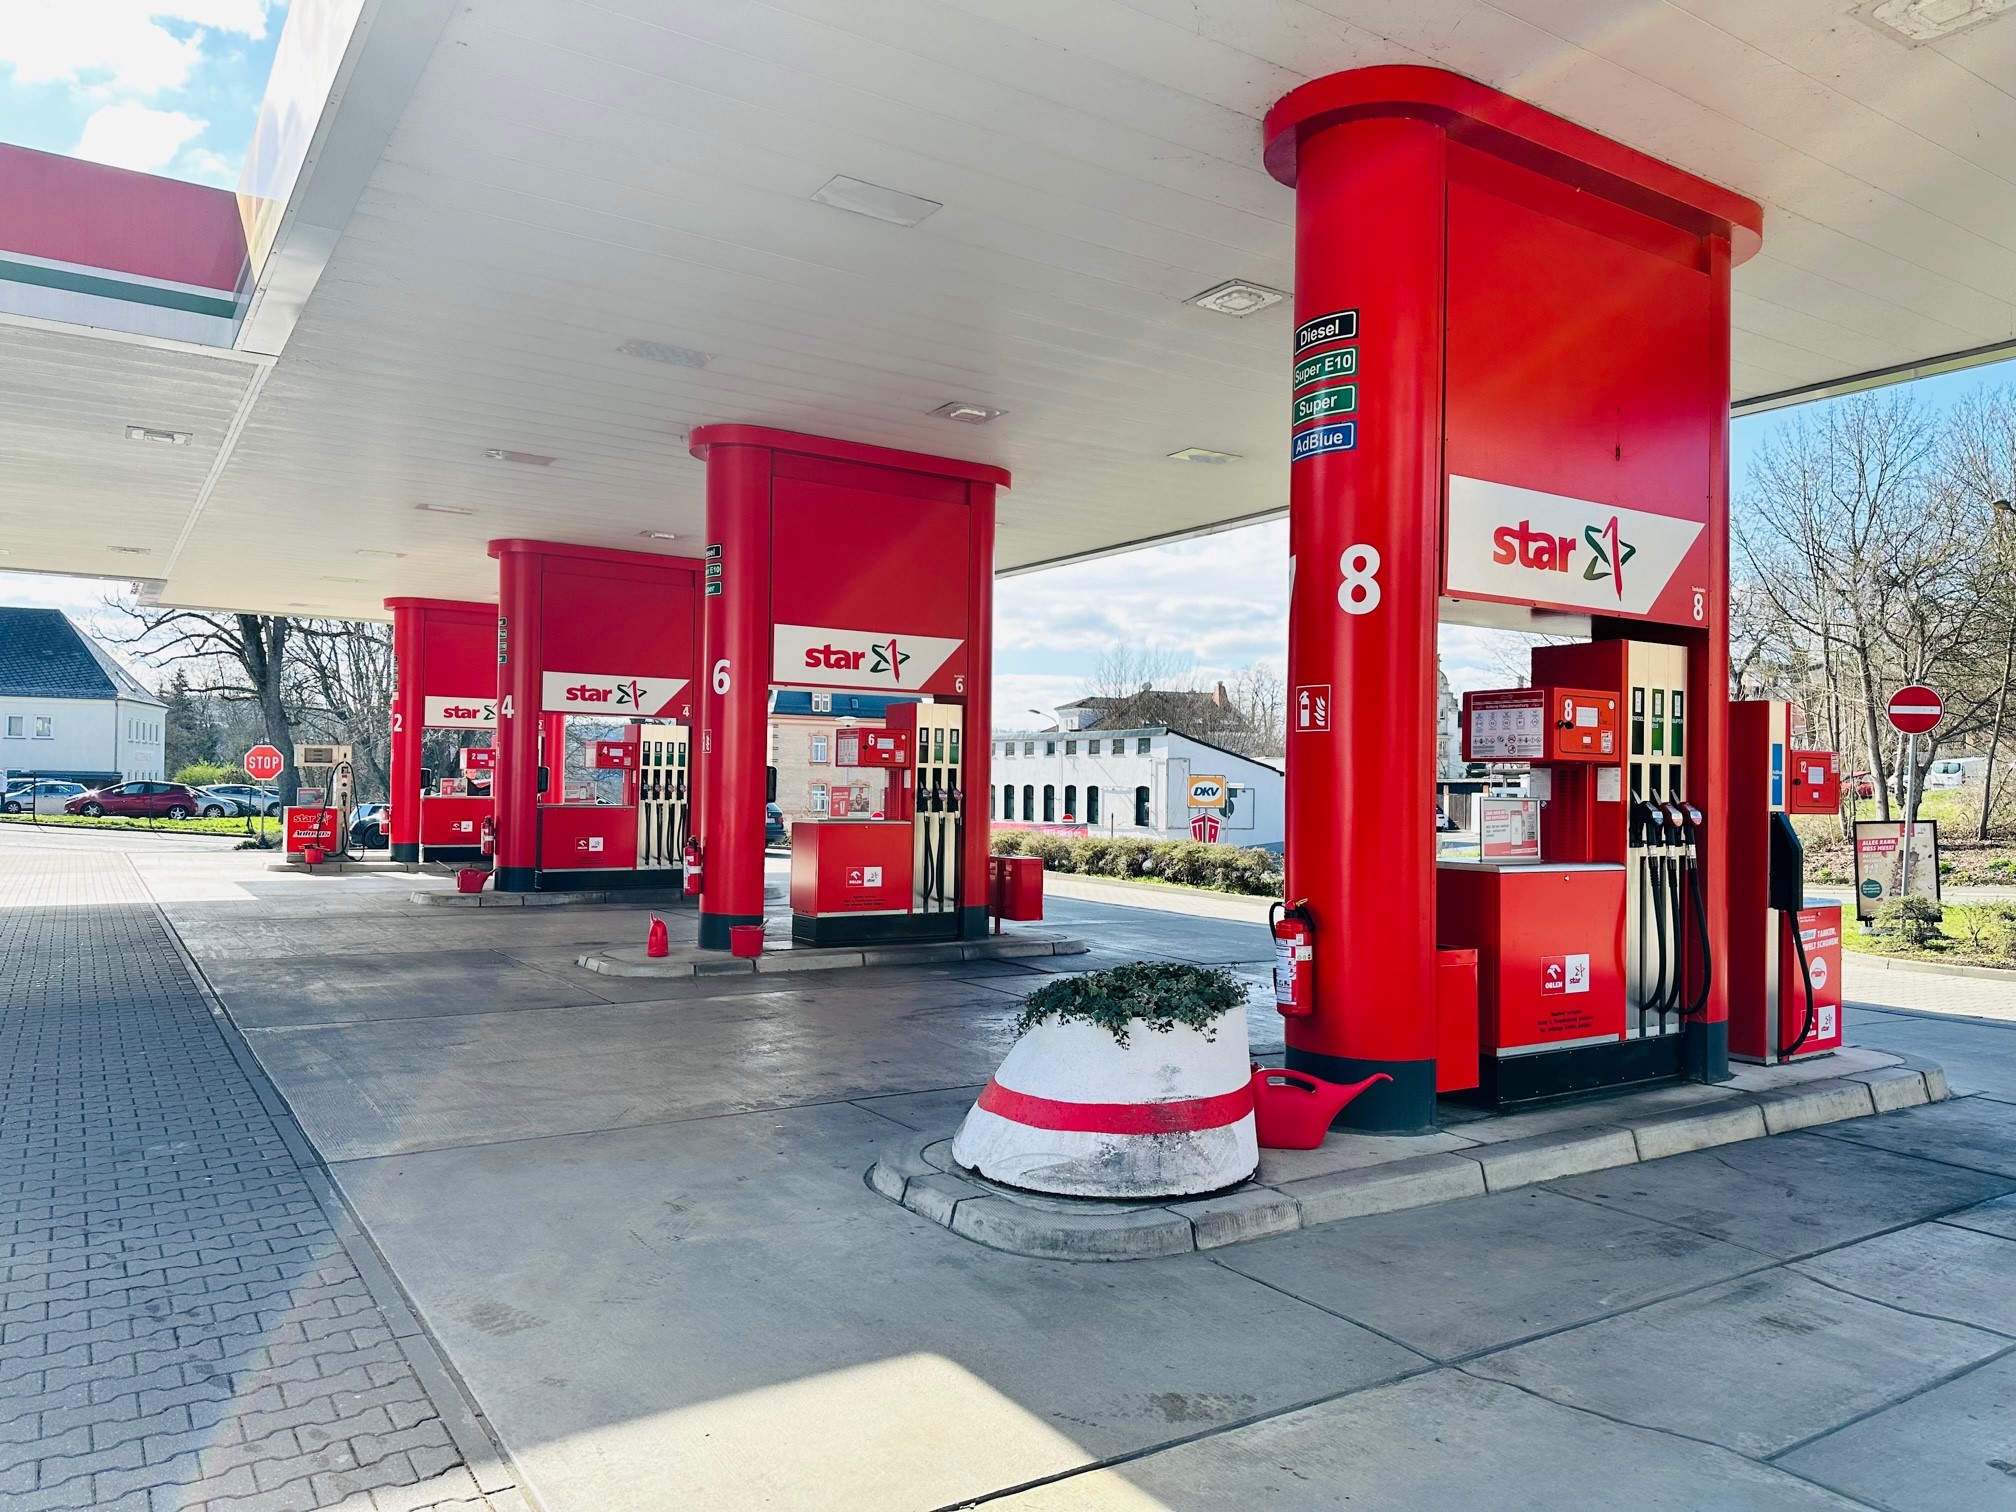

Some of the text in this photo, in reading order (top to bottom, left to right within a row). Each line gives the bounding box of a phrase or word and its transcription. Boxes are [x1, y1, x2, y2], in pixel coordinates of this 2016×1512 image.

[1300, 319, 1339, 347] Diesel
[1295, 354, 1352, 383] Super E10
[1299, 395, 1338, 416] Super
[1295, 432, 1343, 455] AdBlue
[1493, 520, 1577, 573] star
[1337, 543, 1381, 616] 8
[1693, 593, 1704, 621] 8
[804, 644, 865, 670] star
[713, 659, 731, 695] 6
[955, 678, 964, 693] 6
[566, 684, 613, 703] star
[443, 705, 480, 719] star
[501, 694, 515, 719] 4
[682, 706, 690, 717] 4
[1564, 699, 1573, 721] 8
[393, 713, 403, 732] 2
[868, 733, 875, 746] 6
[602, 746, 608, 754] 4
[249, 756, 280, 769] STOP
[1800, 760, 1807, 773] 12
[1193, 786, 1220, 797] DKV
[293, 813, 316, 823] star
[1545, 981, 1563, 989] ORLEN
